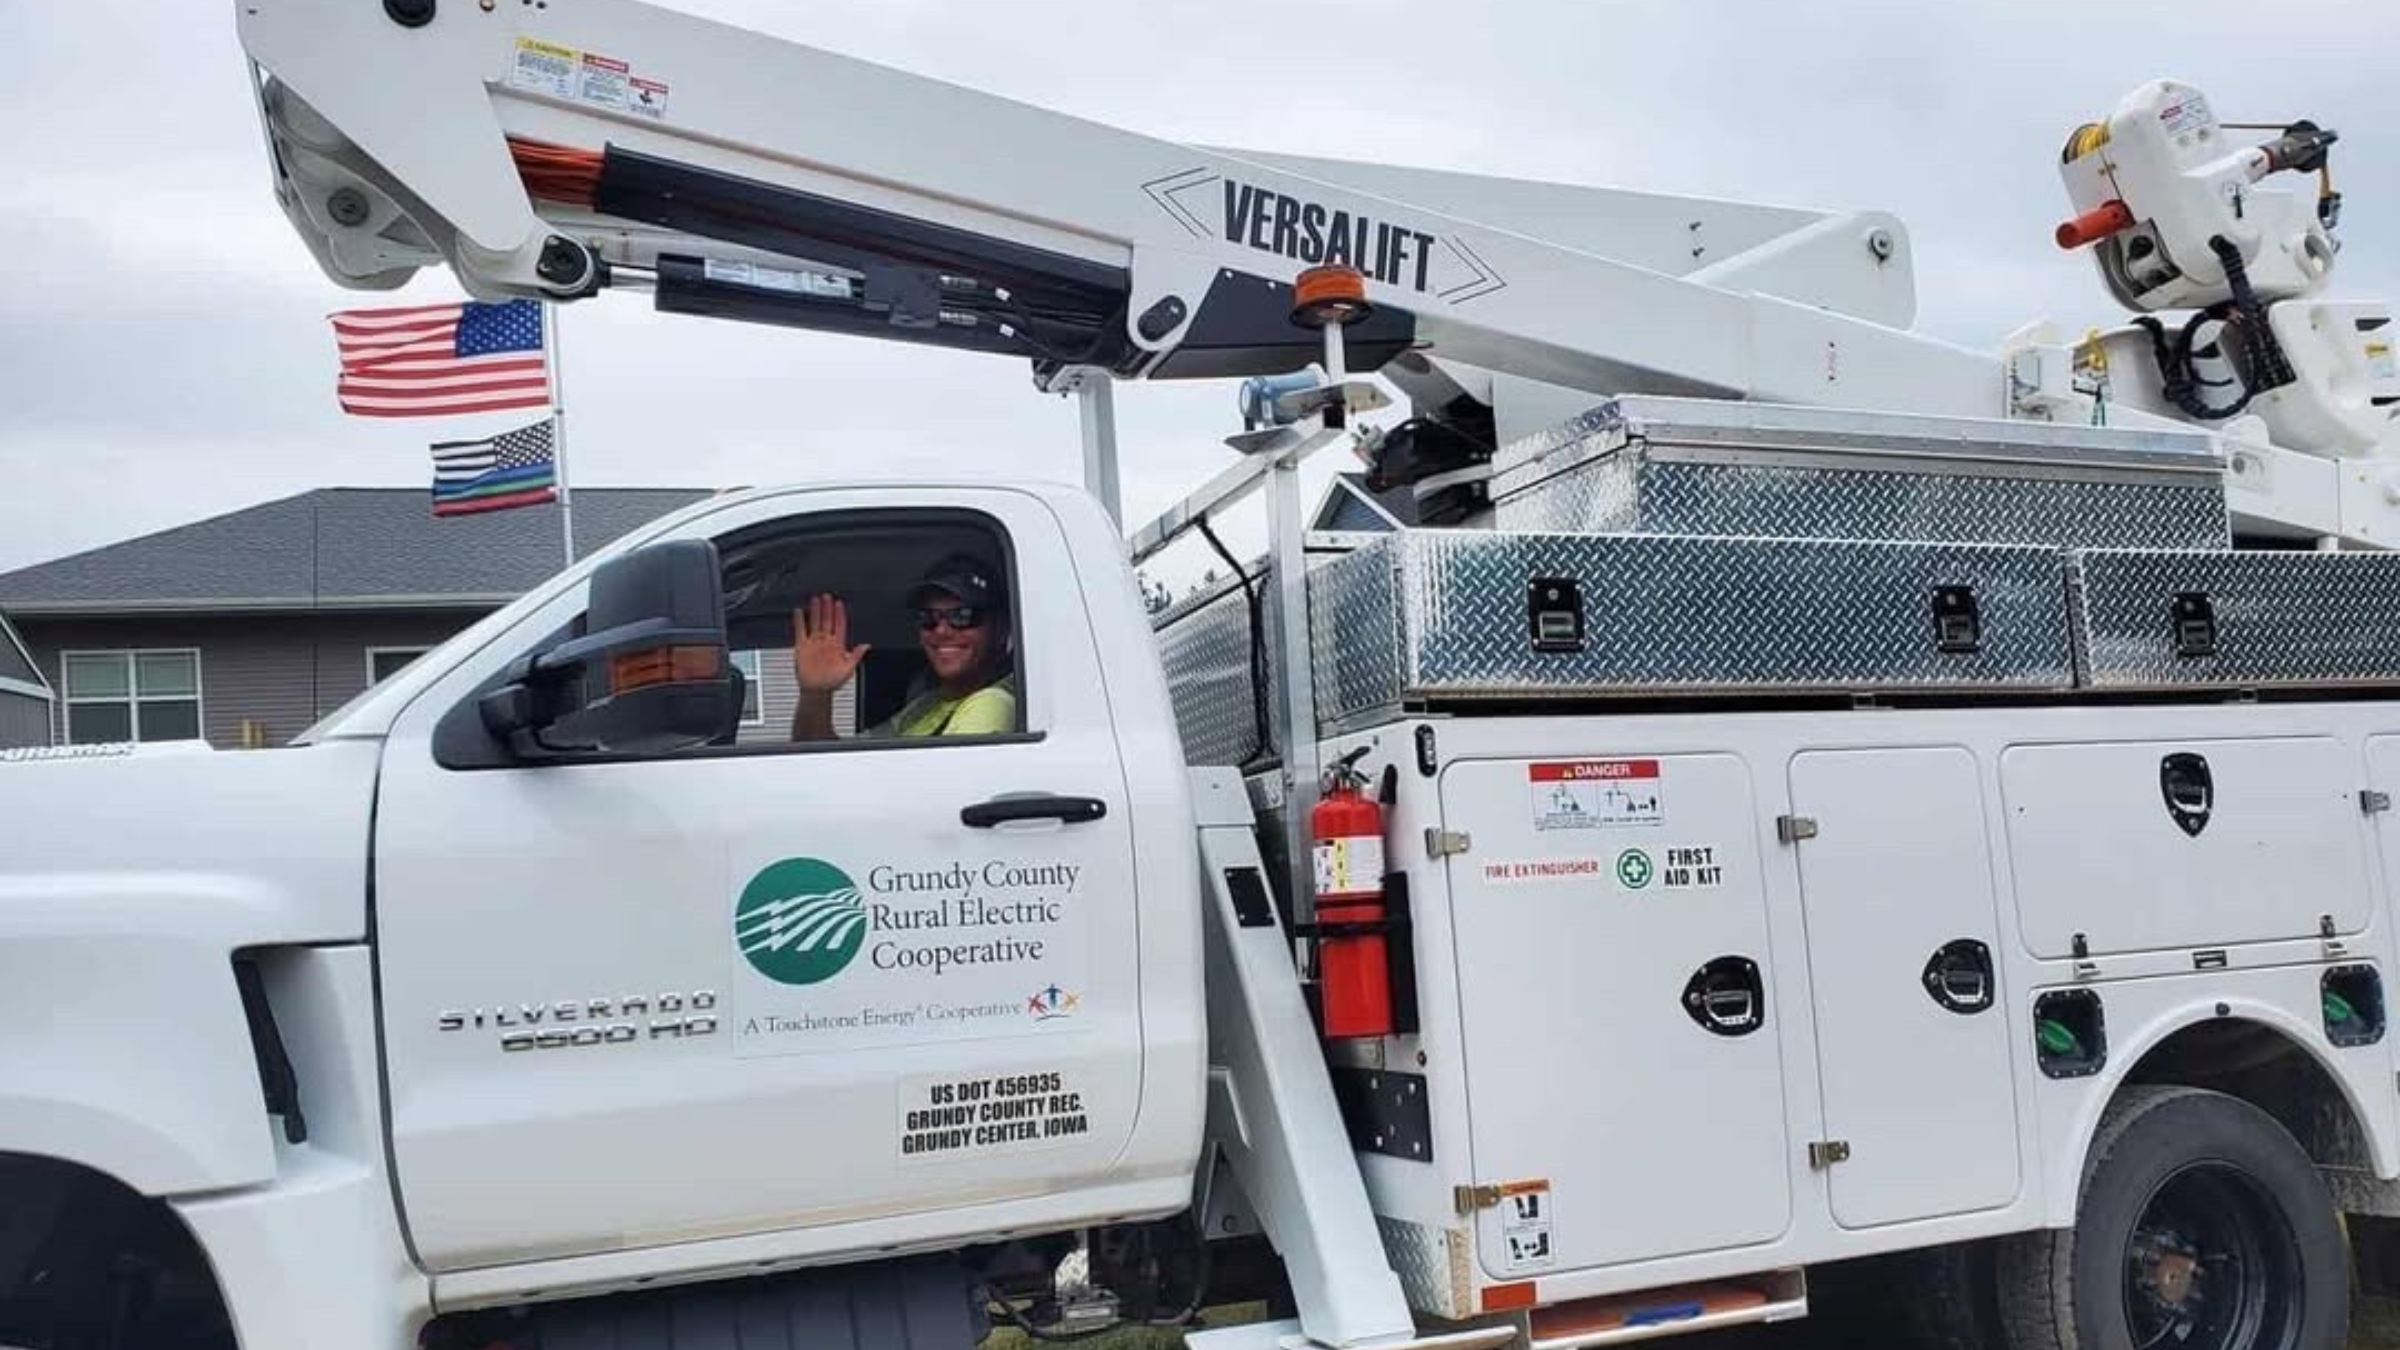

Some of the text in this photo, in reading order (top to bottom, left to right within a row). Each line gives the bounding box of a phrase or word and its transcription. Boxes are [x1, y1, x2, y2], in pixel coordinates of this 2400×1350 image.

[1224, 179, 1435, 292] VERSALIFT
[1574, 764, 1630, 777] DANGER
[1485, 861, 1599, 878] FIRE EXTINGUISHER
[1668, 848, 1712, 865] FIRST
[869, 861, 1080, 896] Grundy County
[1664, 867, 1721, 885] AID KIT
[872, 897, 1060, 931] Rural Electric
[872, 939, 1043, 975] Cooperative
[439, 991, 716, 1031] SILVERADO
[745, 1017, 759, 1034] A
[764, 1015, 859, 1033] Touchstone
[926, 1003, 1021, 1022] Cooperative
[650, 1017, 717, 1039] HD
[931, 1073, 1061, 1104] US DOT 456935
[907, 1093, 1084, 1131] GRUNDY COUNTY REC.
[903, 1115, 1087, 1154] GRUNDY CENTER, IOWA
